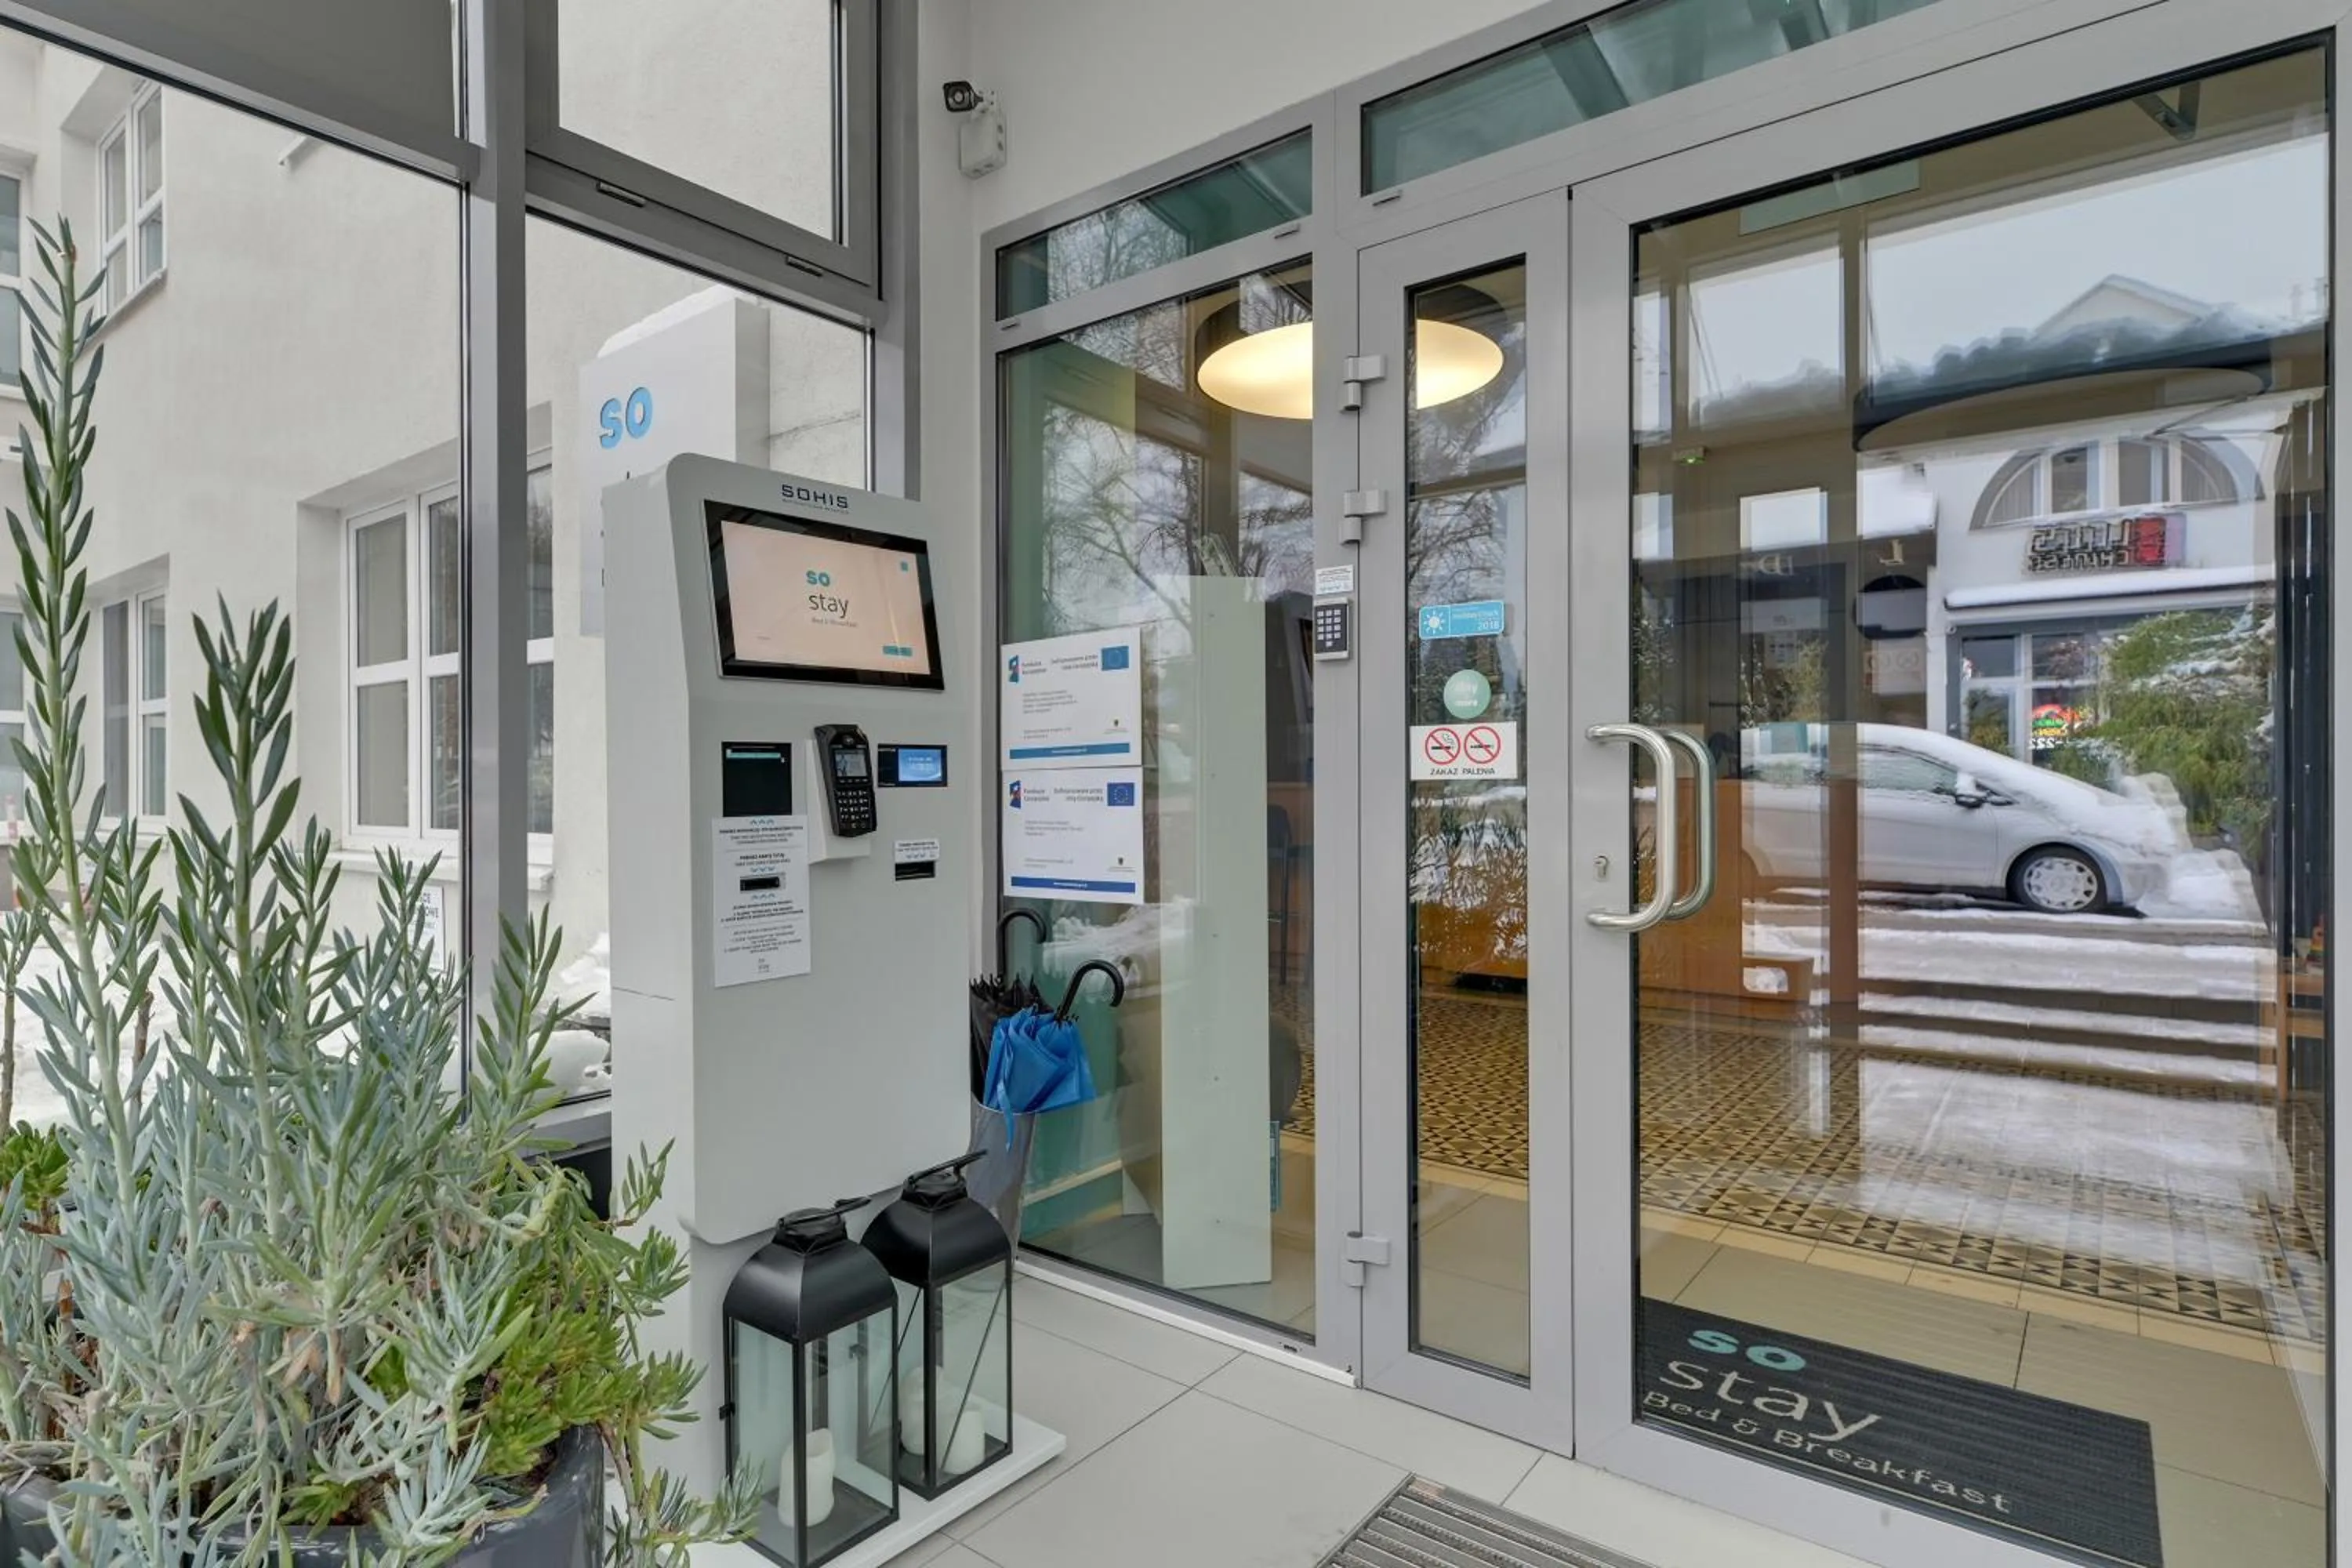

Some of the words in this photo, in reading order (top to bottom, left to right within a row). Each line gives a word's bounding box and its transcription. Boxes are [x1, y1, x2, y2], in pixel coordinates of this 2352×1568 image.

[599, 387, 653, 448] so
[781, 484, 849, 509] SOHIS
[806, 570, 830, 587] so
[808, 593, 849, 619] stay
[1462, 767, 1496, 775] PALENIA
[1687, 1329, 1806, 1371] so
[1659, 1359, 1882, 1442] stay
[1642, 1391, 1722, 1423] Bed
[1732, 1417, 1761, 1435] &
[1773, 1428, 2012, 1514] Breakfast
